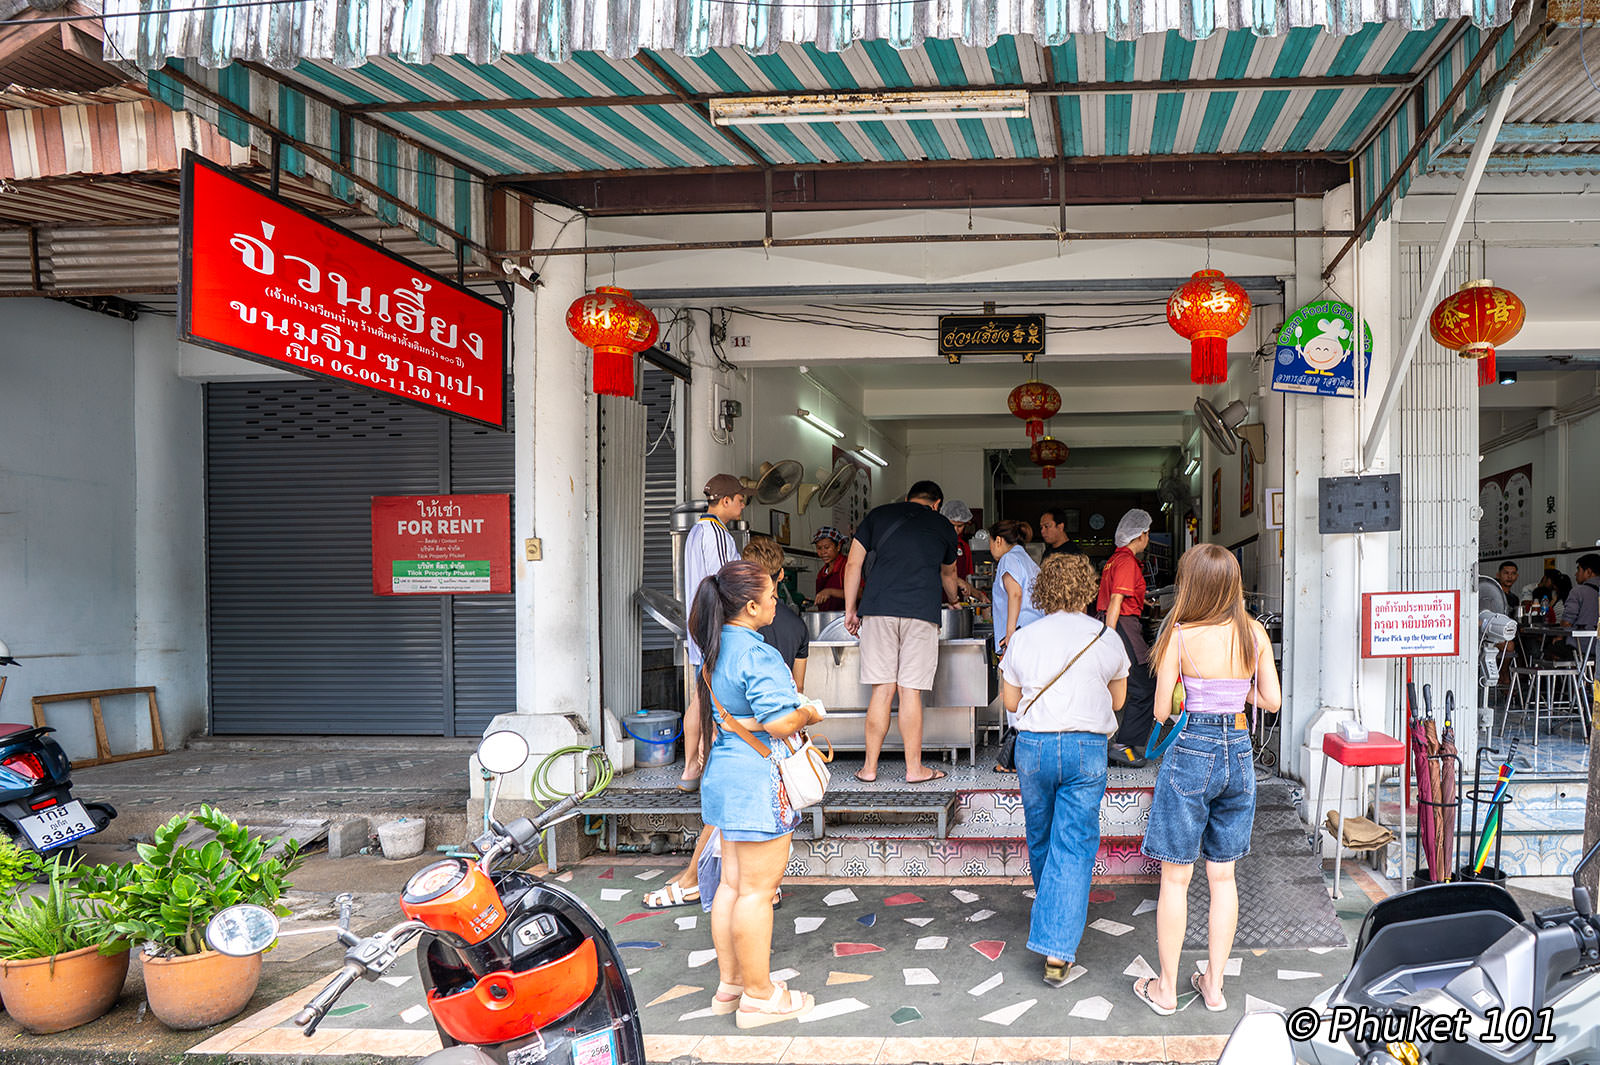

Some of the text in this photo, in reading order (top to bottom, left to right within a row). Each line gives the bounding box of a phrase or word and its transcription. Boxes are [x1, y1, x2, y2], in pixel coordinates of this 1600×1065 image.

[230, 220, 484, 361] จ่วนเฮี้ยง
[1279, 315, 1303, 345] Clean
[1301, 303, 1329, 319] Food
[230, 300, 484, 401] ขนมจีบ ซาลาเปา
[734, 336, 747, 348] 11
[286, 343, 452, 406] เปิด 06.00-11.30 น.
[417, 500, 461, 518] ให้เช่า
[397, 519, 485, 535] FOR RENT
[1374, 620, 1399, 634] กรุณา
[1373, 635, 1390, 643] Please
[1391, 634, 1402, 642] Pick
[1420, 634, 1438, 642] Queue
[41, 822, 86, 844] 3343
[50, 819, 68, 830] ภูเก็ต
[591, 1044, 610, 1058] 2568
